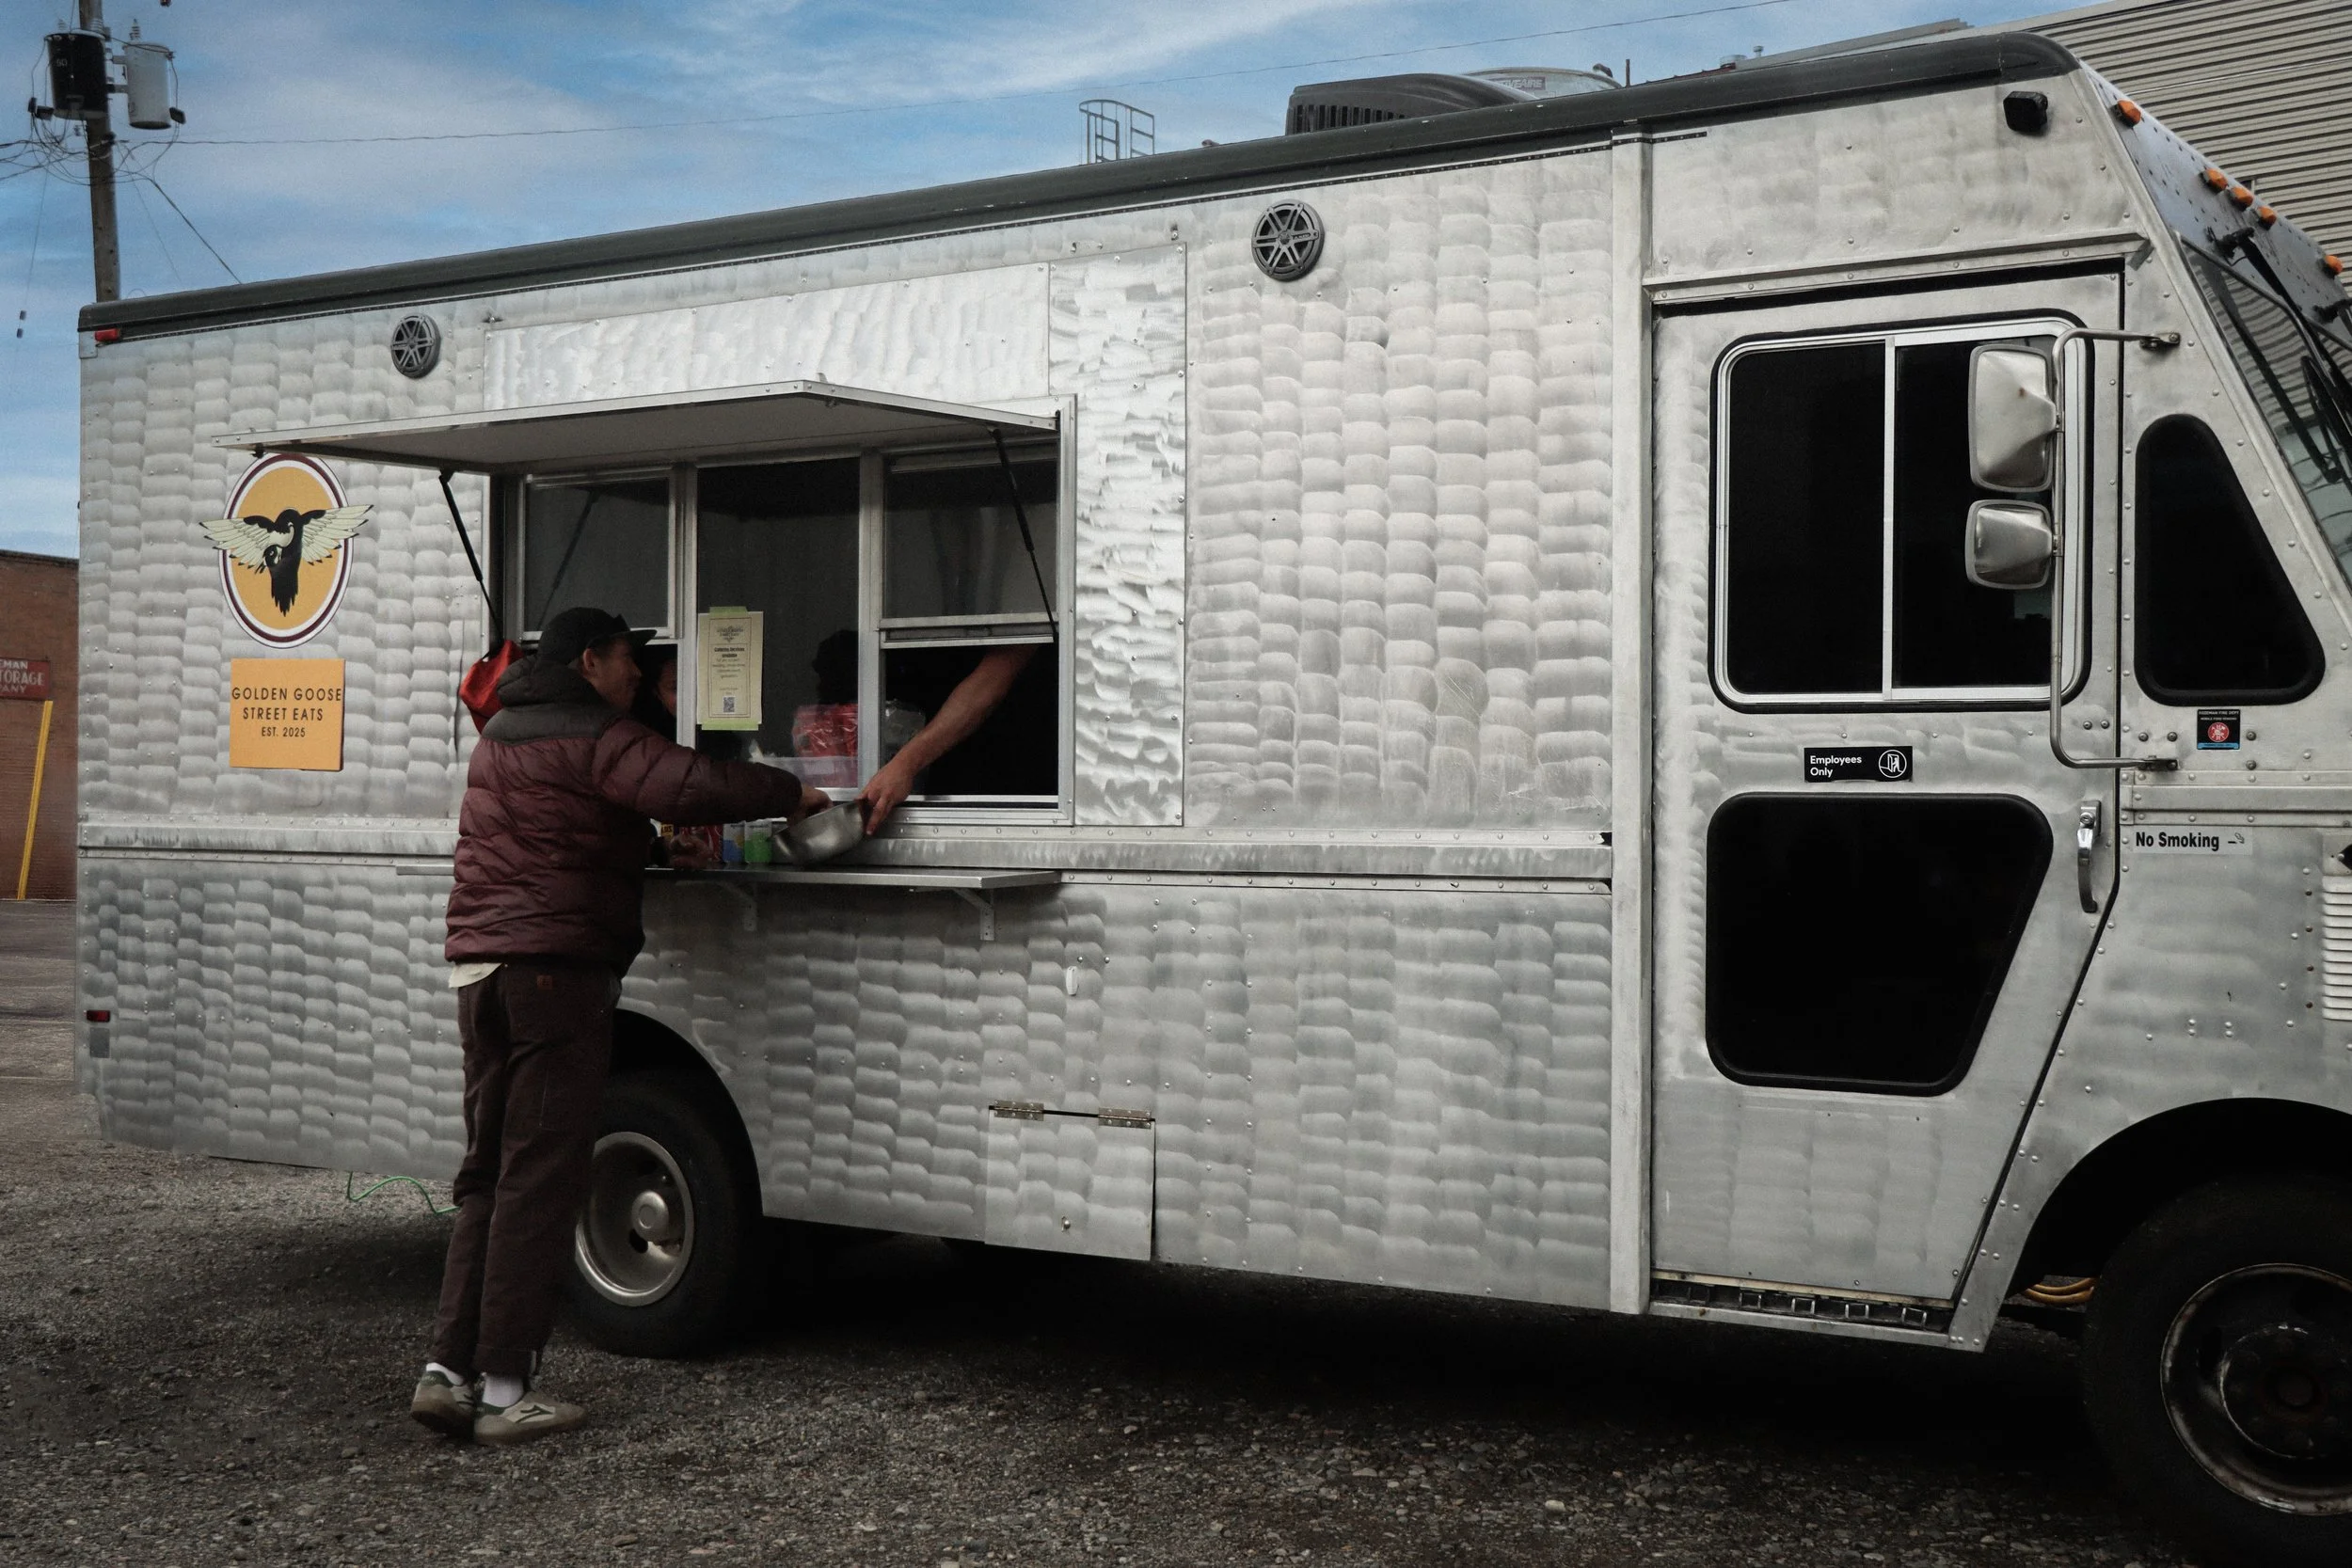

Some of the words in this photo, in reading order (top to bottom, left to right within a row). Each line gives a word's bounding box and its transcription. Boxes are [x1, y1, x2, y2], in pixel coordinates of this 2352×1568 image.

[231, 687, 287, 701] GOLDEN
[294, 688, 342, 702] GOOSE
[243, 707, 287, 721] STREET
[293, 708, 323, 721] EATS
[262, 726, 279, 736] EST.
[283, 727, 306, 737] 2025
[1810, 755, 1863, 767] Employees
[1810, 767, 1833, 778] Only
[2136, 832, 2153, 847] No
[2158, 832, 2219, 851] Smoking
